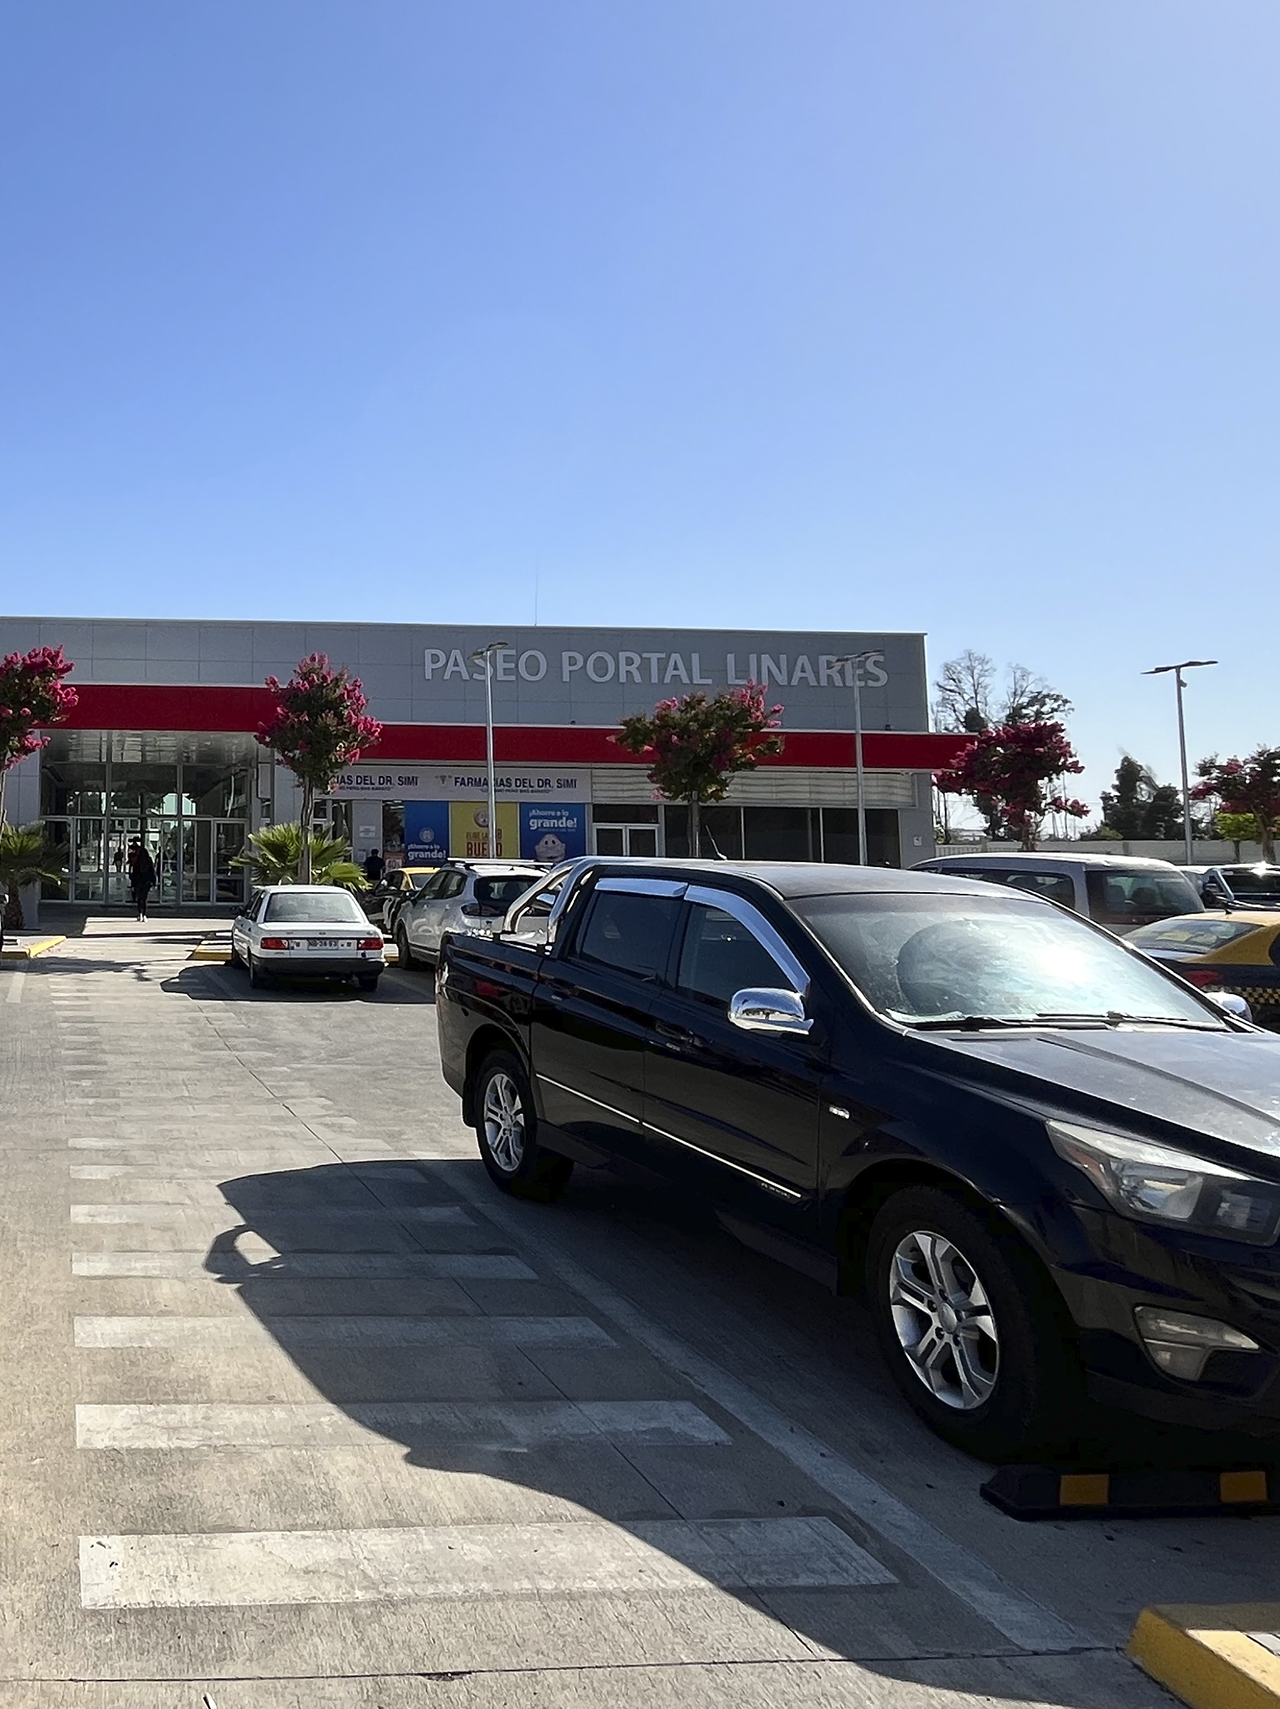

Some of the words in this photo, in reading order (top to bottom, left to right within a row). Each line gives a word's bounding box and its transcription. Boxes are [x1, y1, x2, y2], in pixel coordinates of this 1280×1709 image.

[424, 648, 548, 682] PASEO
[561, 650, 713, 685] PORTAL
[727, 652, 889, 688] LINARES
[355, 775, 375, 786] DEL
[378, 775, 395, 787] DR.
[397, 775, 419, 786] SIMI
[454, 777, 512, 788] FARMAIAS
[515, 778, 534, 788] DEL
[537, 778, 554, 789] DR.
[556, 778, 577, 789] SIMI
[529, 817, 577, 830] grande!
[466, 841, 503, 856] BUEO
[407, 850, 446, 860] grande!
